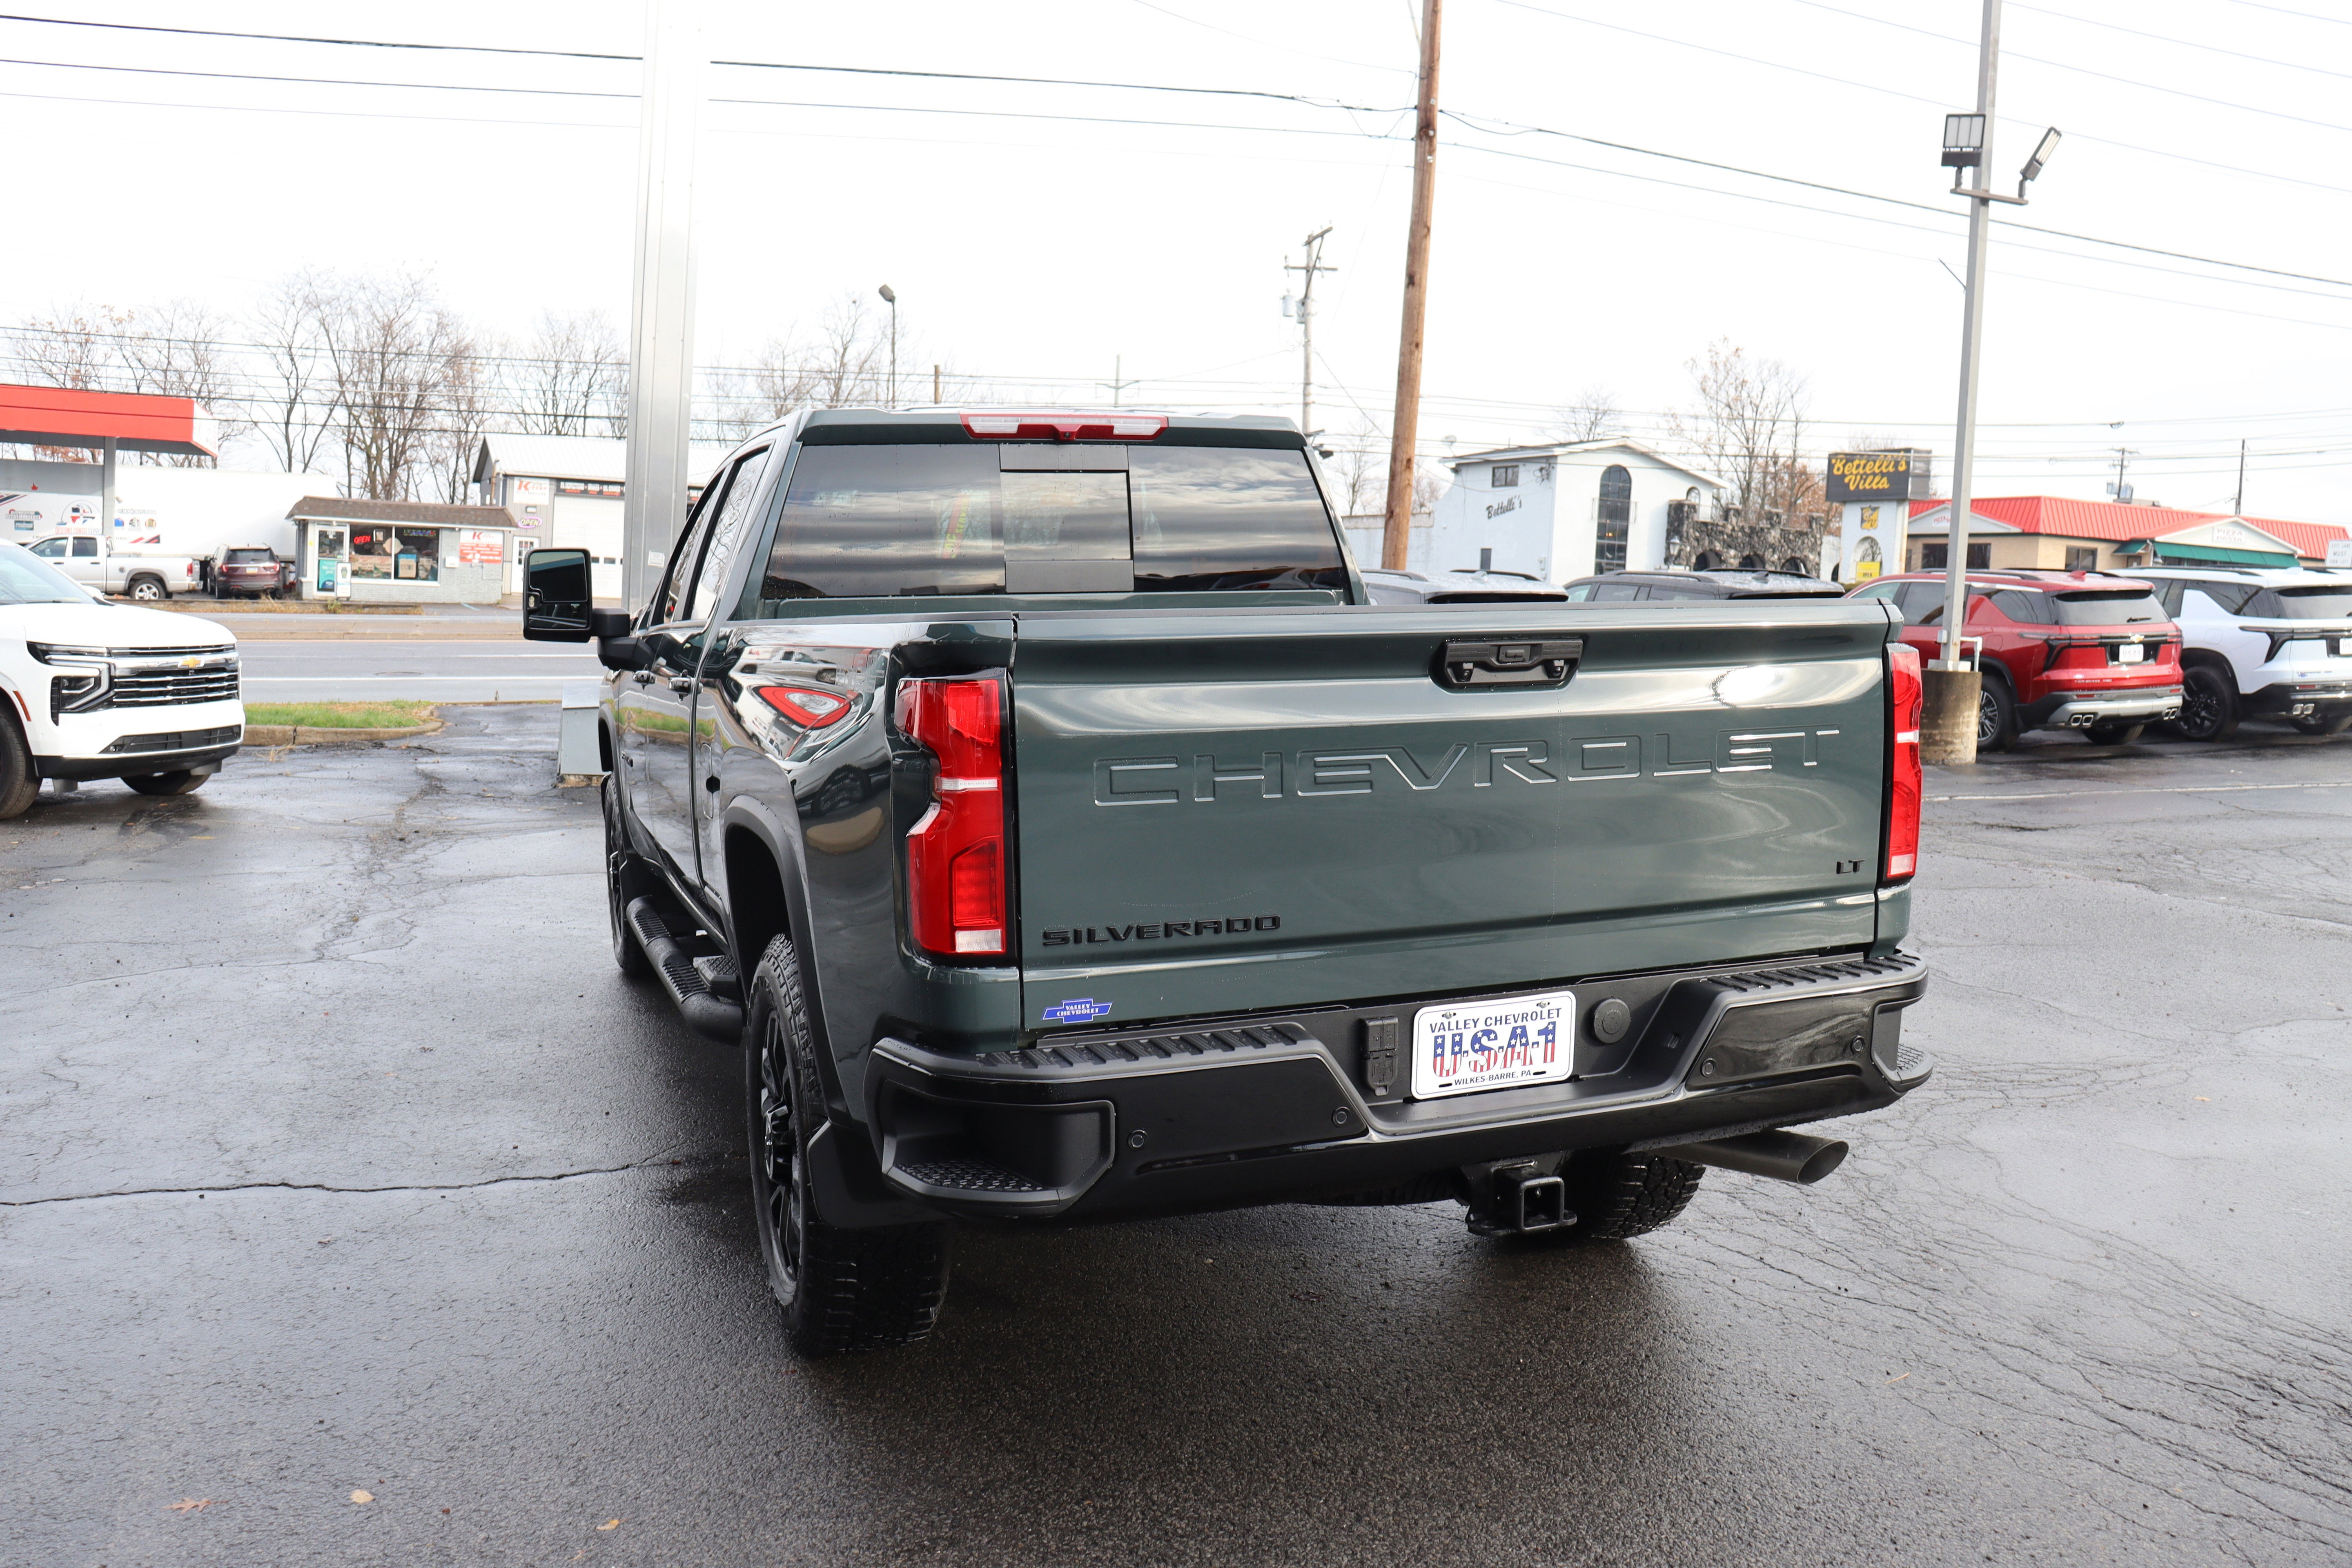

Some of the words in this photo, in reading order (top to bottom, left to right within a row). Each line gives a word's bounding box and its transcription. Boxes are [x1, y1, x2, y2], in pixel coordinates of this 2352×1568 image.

[1831, 451, 1907, 475] Bettelli's
[1844, 474, 1890, 490] Villa
[1486, 494, 1521, 519] Bettelli's
[354, 536, 371, 544] OPEN
[1093, 724, 1840, 806] CHEVROLET
[1836, 859, 1865, 874] LT
[1043, 914, 1281, 946] SILVERADO
[1056, 1007, 1100, 1017] CHEVROLET
[1430, 1018, 1480, 1033] VALLEY
[1484, 1008, 1562, 1028] CHEVROLET
[1454, 1071, 1519, 1086] WILKES-BARRE,
